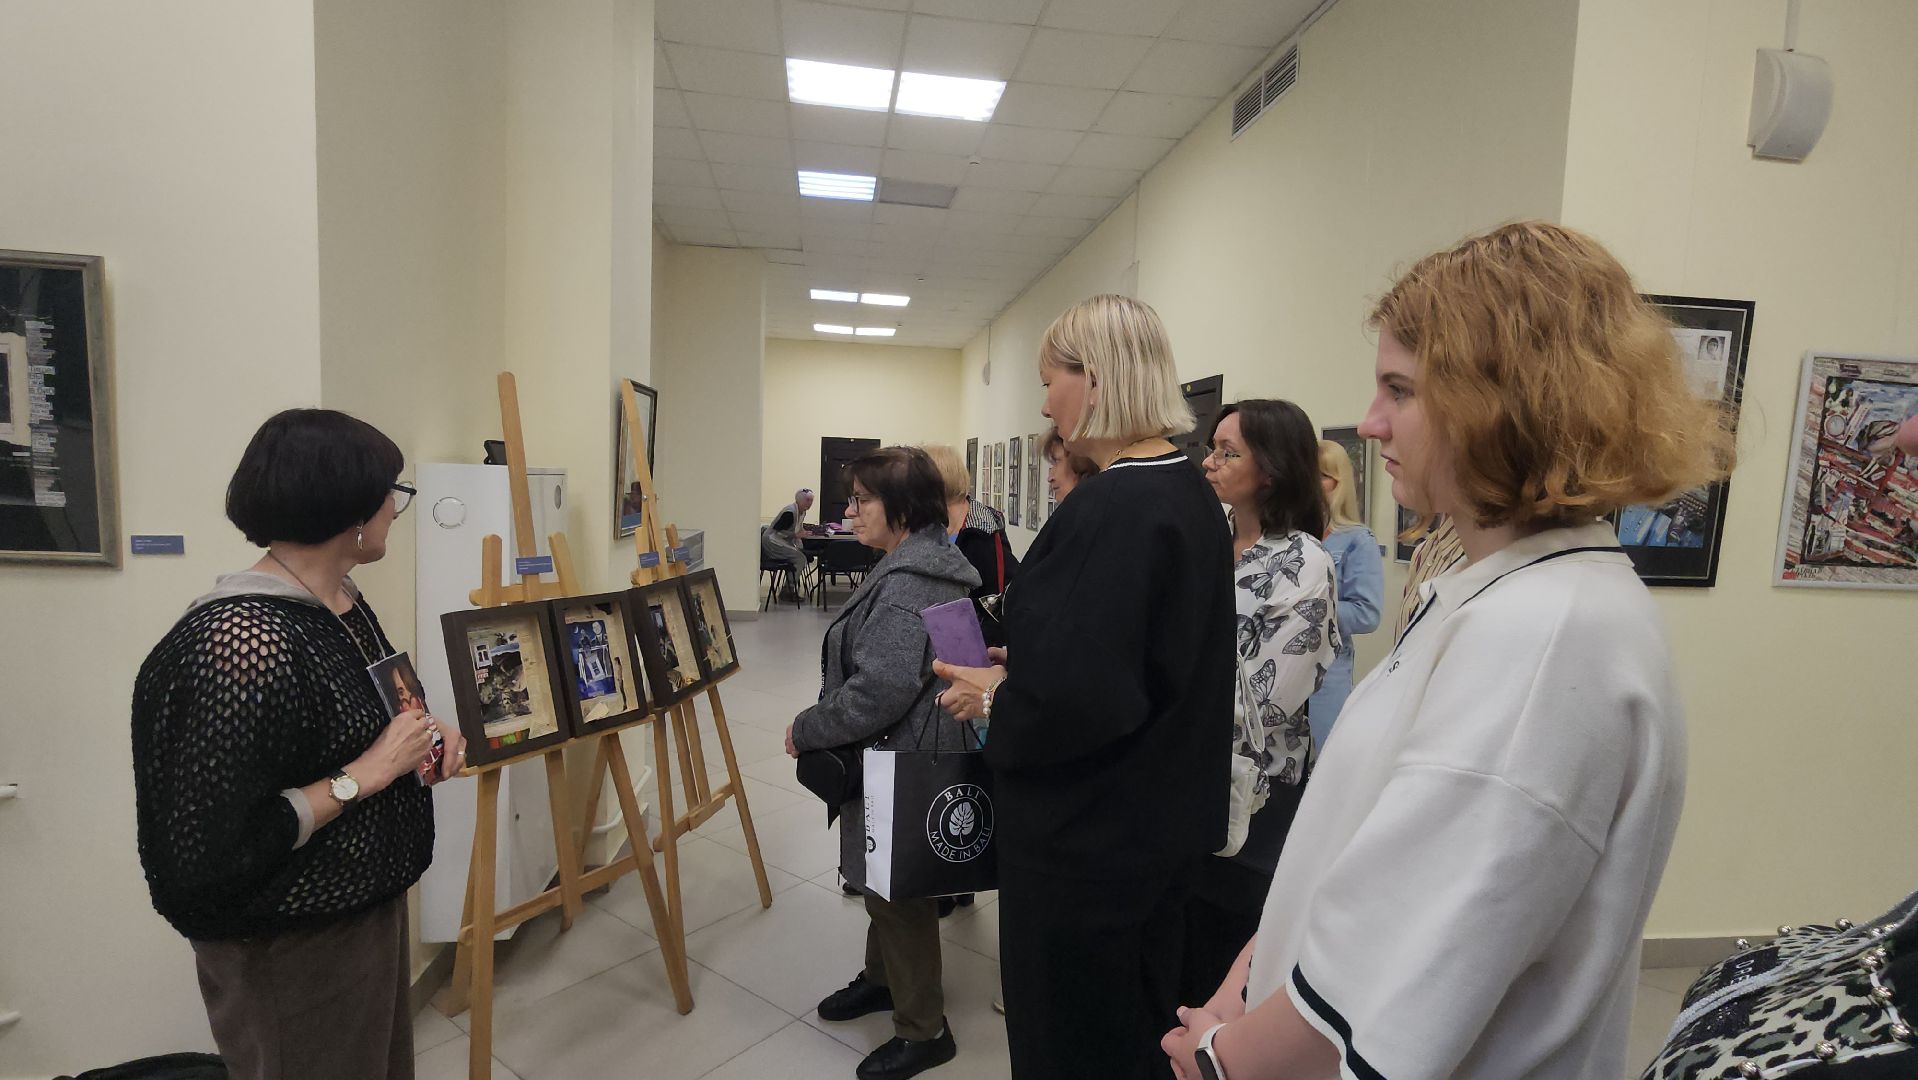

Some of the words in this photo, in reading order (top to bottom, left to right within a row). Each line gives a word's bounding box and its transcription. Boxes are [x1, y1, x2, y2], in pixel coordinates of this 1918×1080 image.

[944, 787, 980, 802] BALI
[930, 830, 956, 860] MADE
[959, 850, 971, 860] IN
[973, 827, 992, 853] BALI
